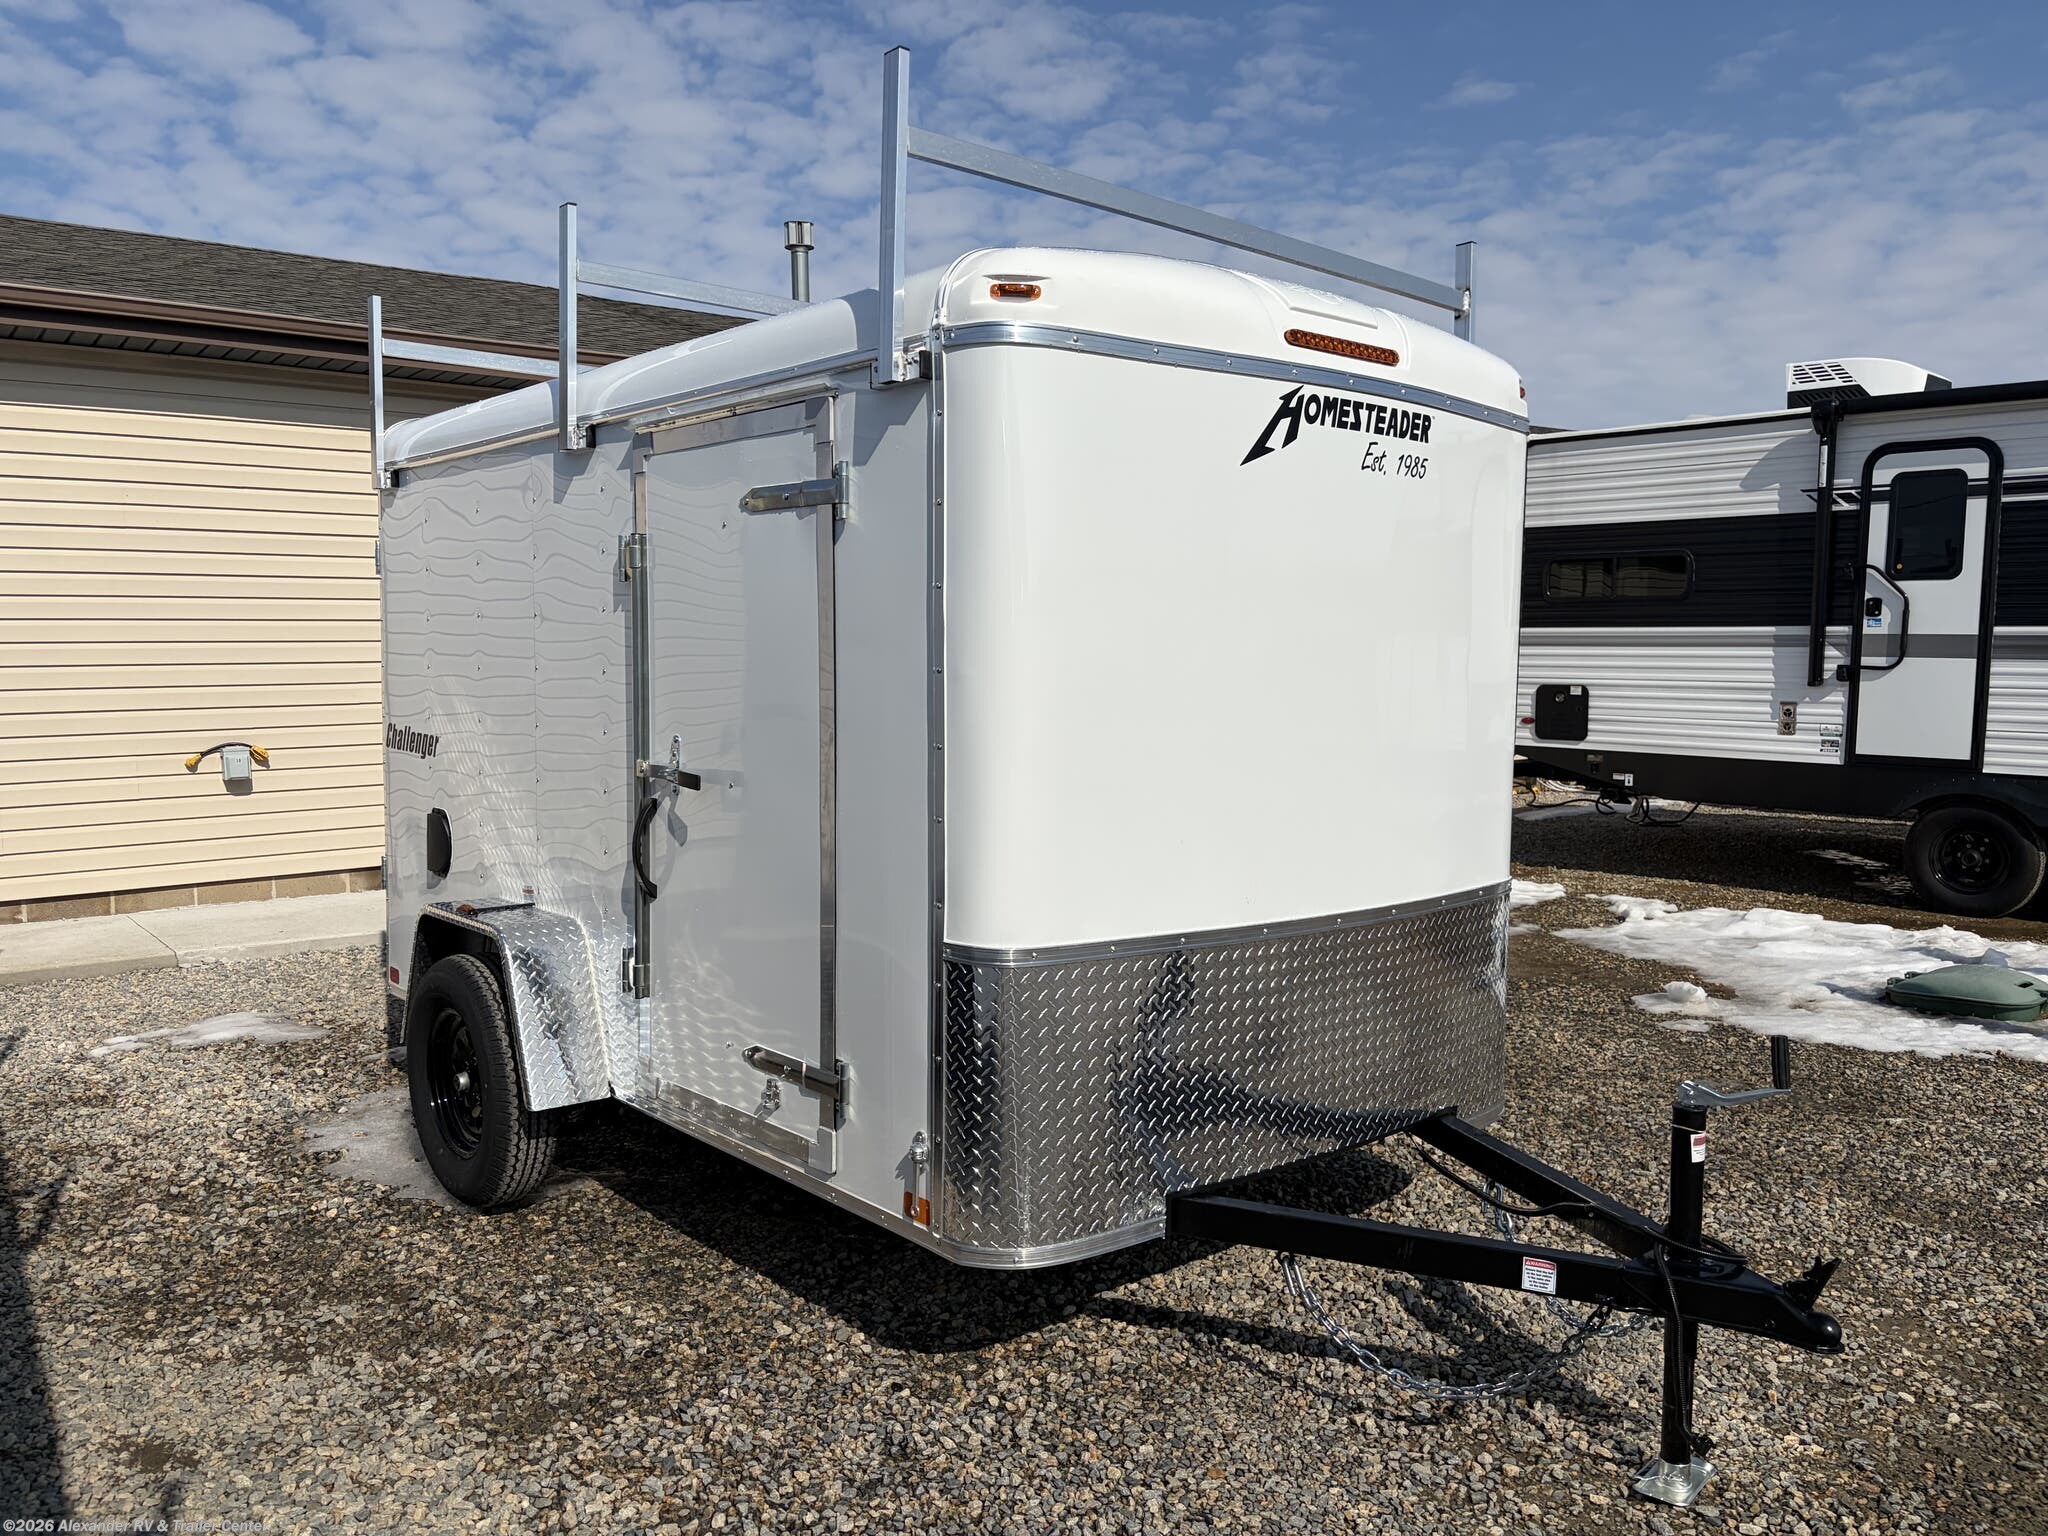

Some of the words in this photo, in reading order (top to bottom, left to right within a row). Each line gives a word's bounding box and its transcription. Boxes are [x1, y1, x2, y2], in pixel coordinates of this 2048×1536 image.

[1240, 385, 1433, 466] HOMESTEADER
[1361, 441, 1387, 476] Est.
[1396, 453, 1429, 480] 1985
[386, 722, 440, 759] Challenger
